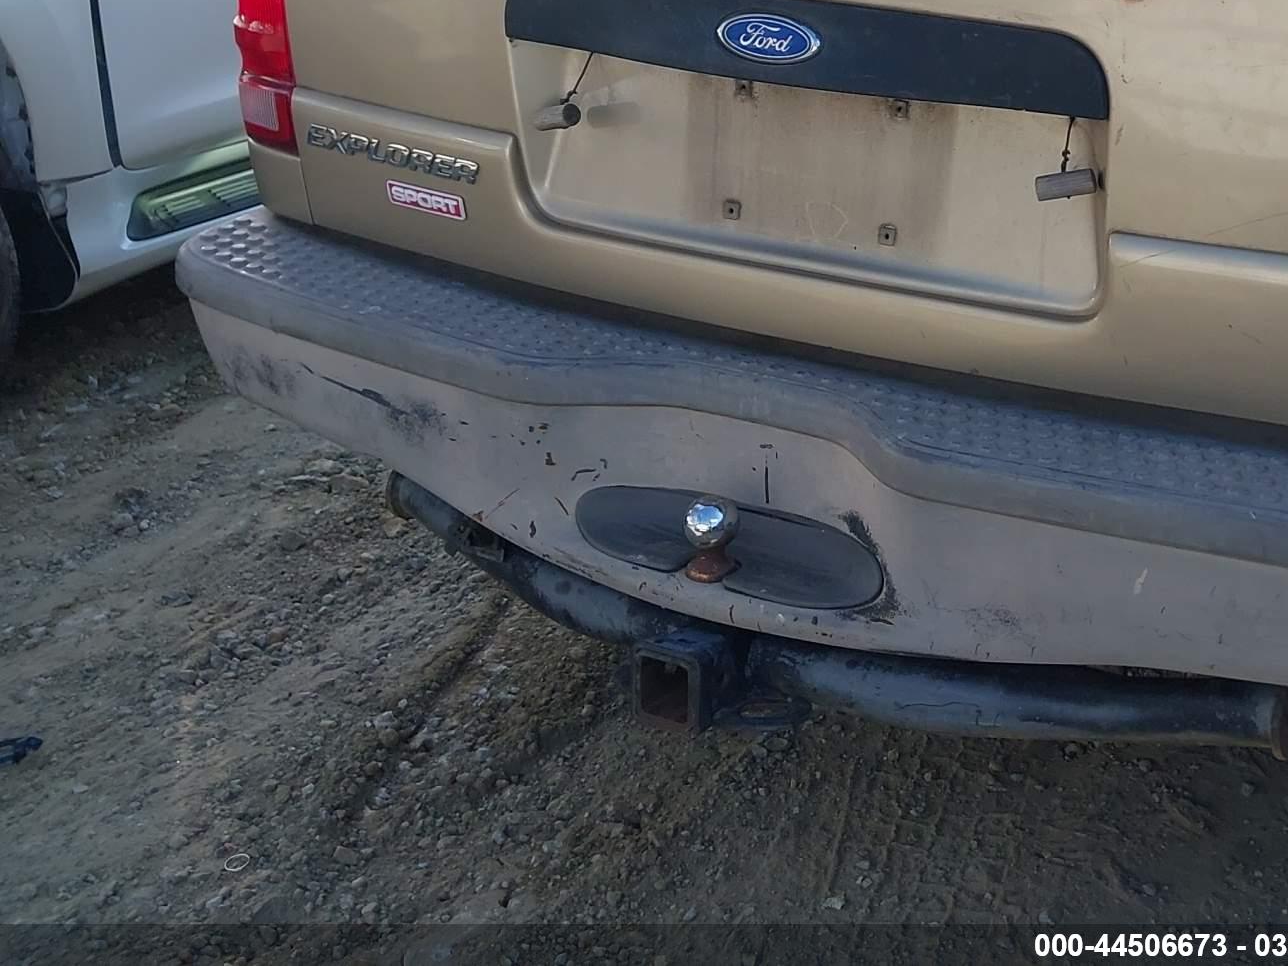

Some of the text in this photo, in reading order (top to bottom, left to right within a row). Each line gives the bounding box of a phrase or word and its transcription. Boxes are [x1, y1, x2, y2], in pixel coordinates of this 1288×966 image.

[739, 22, 793, 52] Ford
[307, 123, 480, 184] EXPLORER
[391, 187, 458, 214] SPORT
